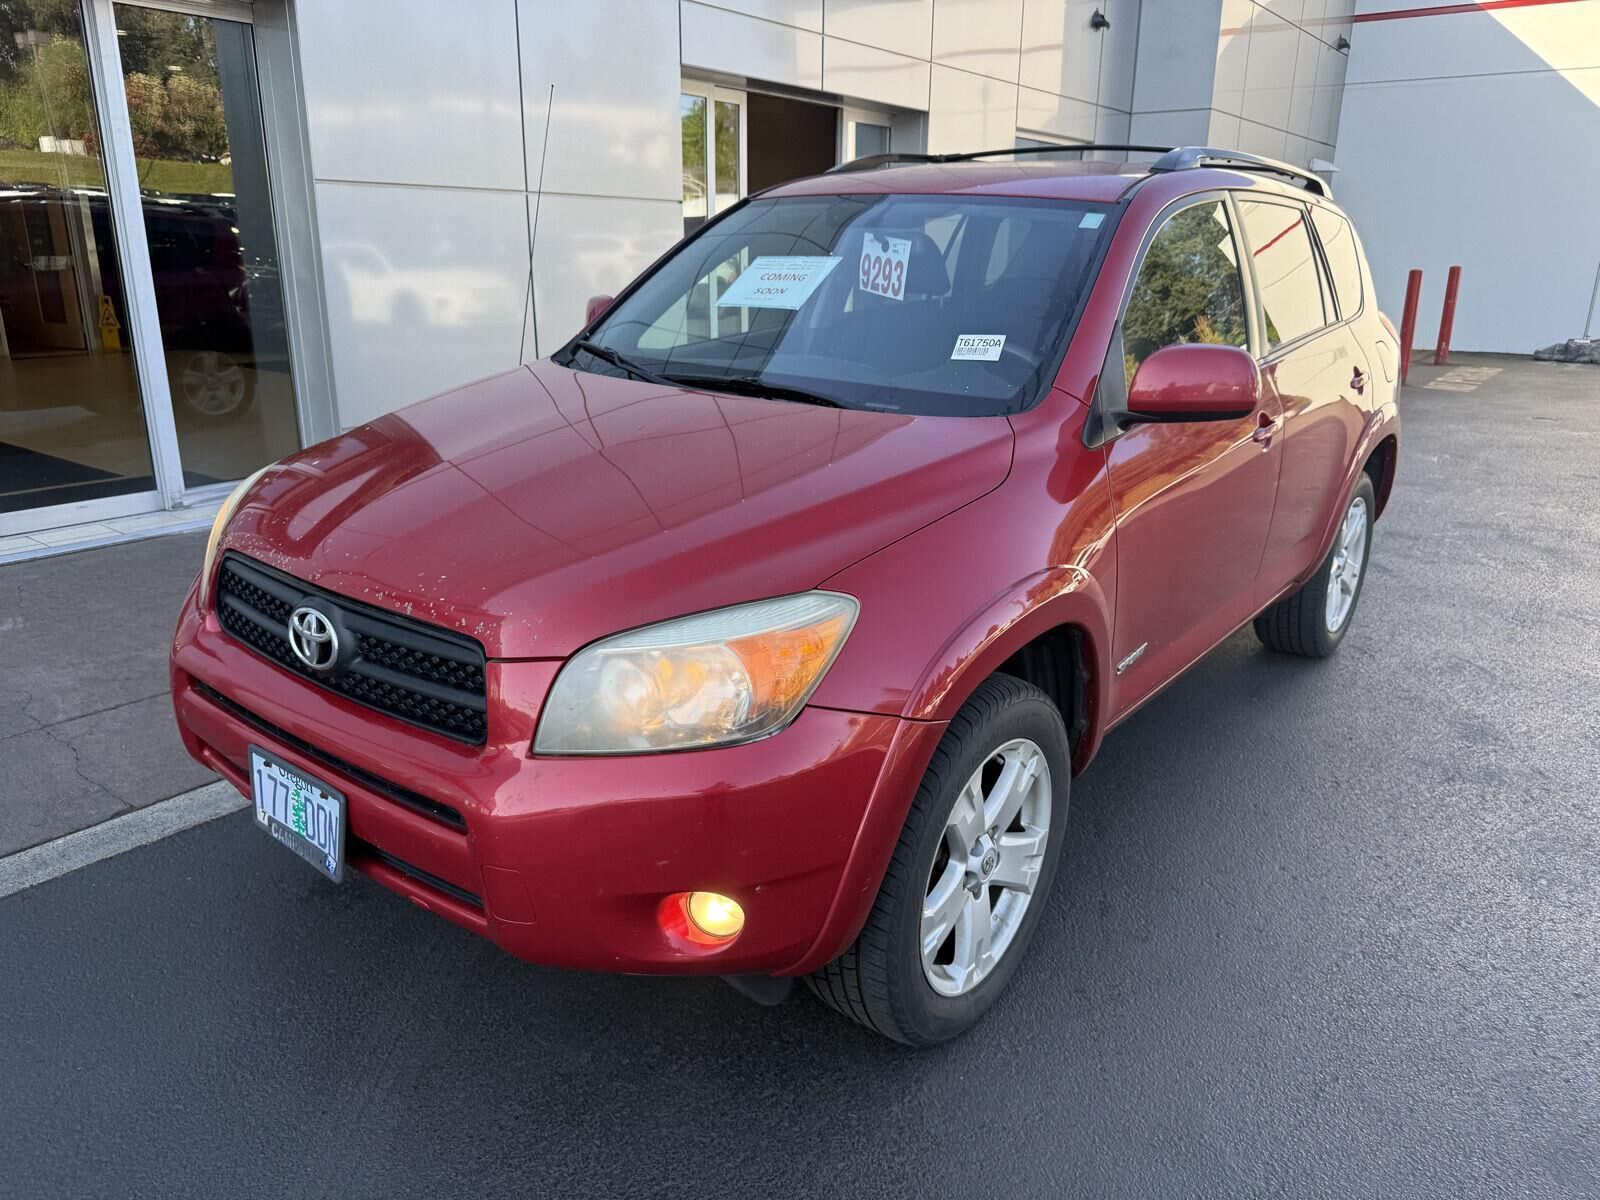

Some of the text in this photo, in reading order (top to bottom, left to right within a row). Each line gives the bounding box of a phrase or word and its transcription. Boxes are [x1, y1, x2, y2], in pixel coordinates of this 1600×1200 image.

[760, 273, 808, 282] COMING
[861, 253, 904, 297] 9293
[754, 287, 788, 295] SOON
[257, 768, 290, 824] 177
